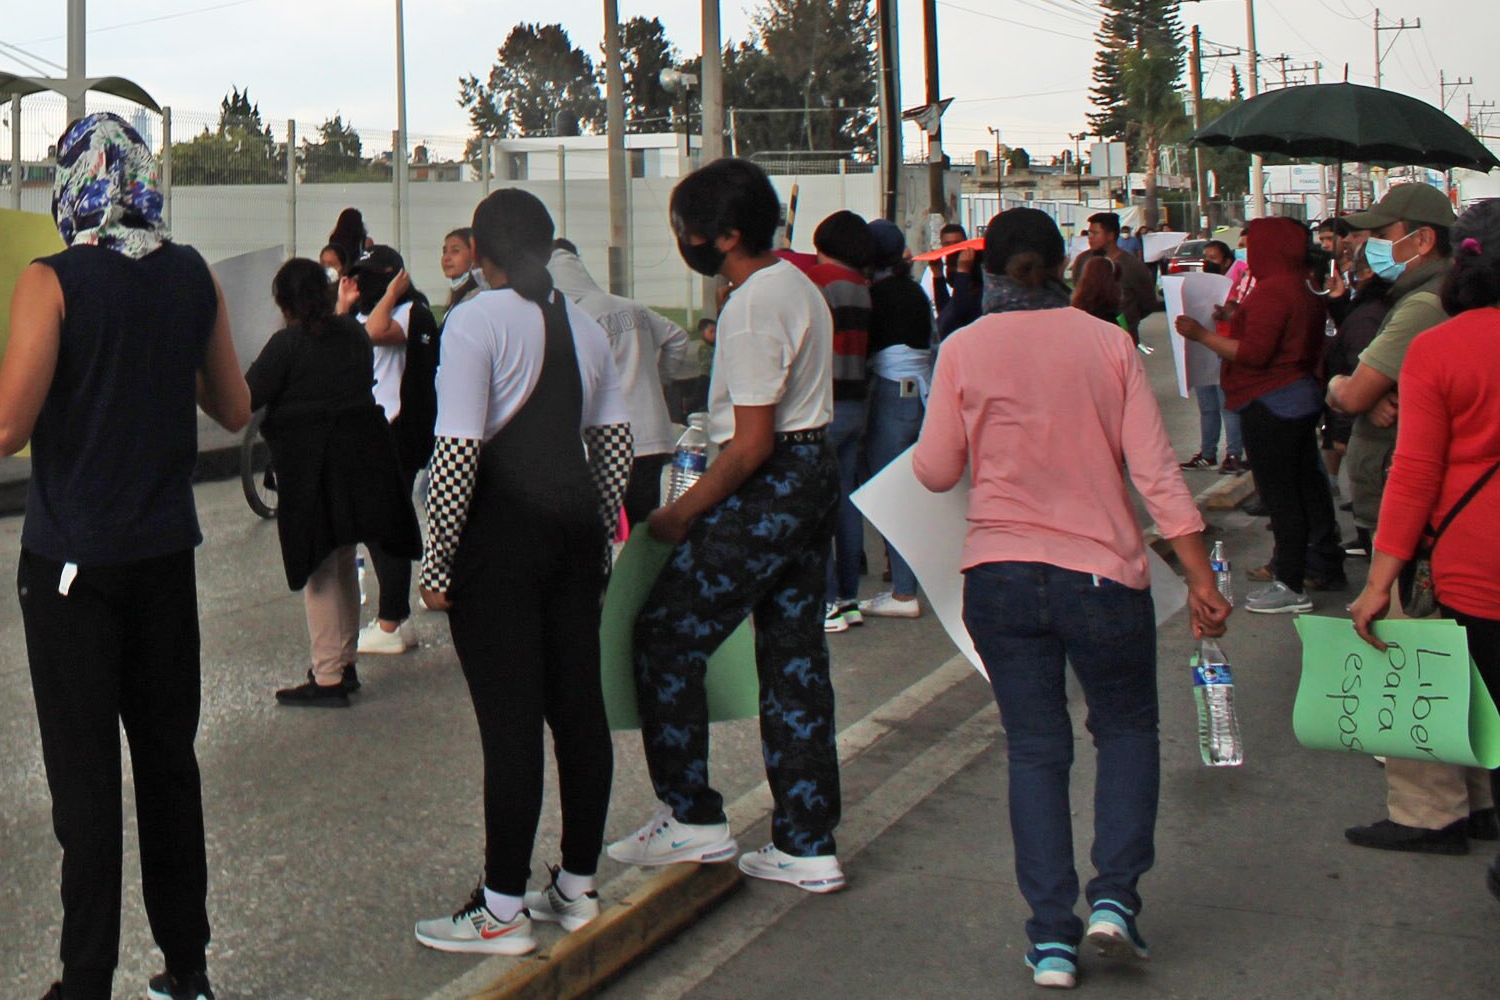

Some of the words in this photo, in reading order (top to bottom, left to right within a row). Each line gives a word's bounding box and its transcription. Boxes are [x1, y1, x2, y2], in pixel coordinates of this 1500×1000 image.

[1325, 652, 1365, 752] espos
[1376, 640, 1407, 733] para
[1409, 648, 1451, 763] Liber
